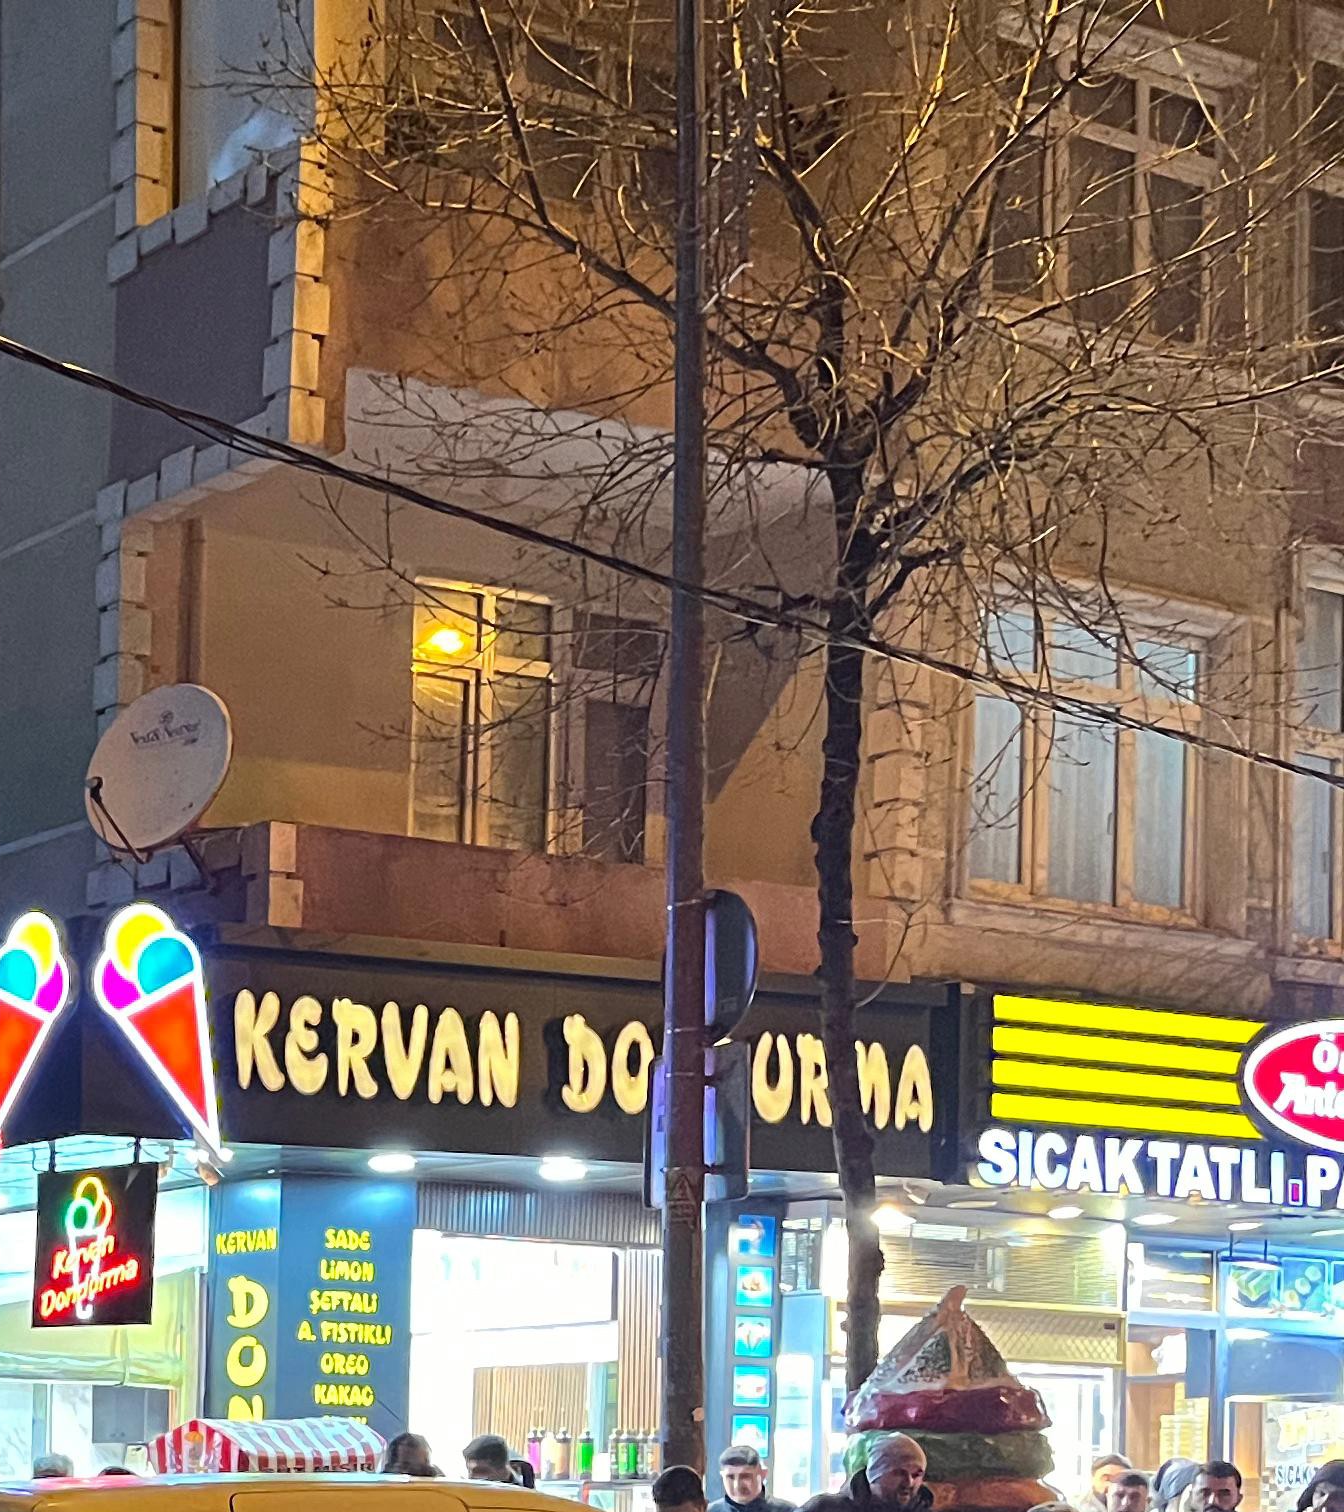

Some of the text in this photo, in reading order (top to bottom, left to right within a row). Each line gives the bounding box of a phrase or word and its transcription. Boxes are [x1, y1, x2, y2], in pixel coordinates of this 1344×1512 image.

[234, 989, 934, 1133] KERVAN DOURMA
[216, 1228, 277, 1255] KERVAN
[325, 1228, 371, 1251] SADE
[320, 1352, 370, 1375] OREO
